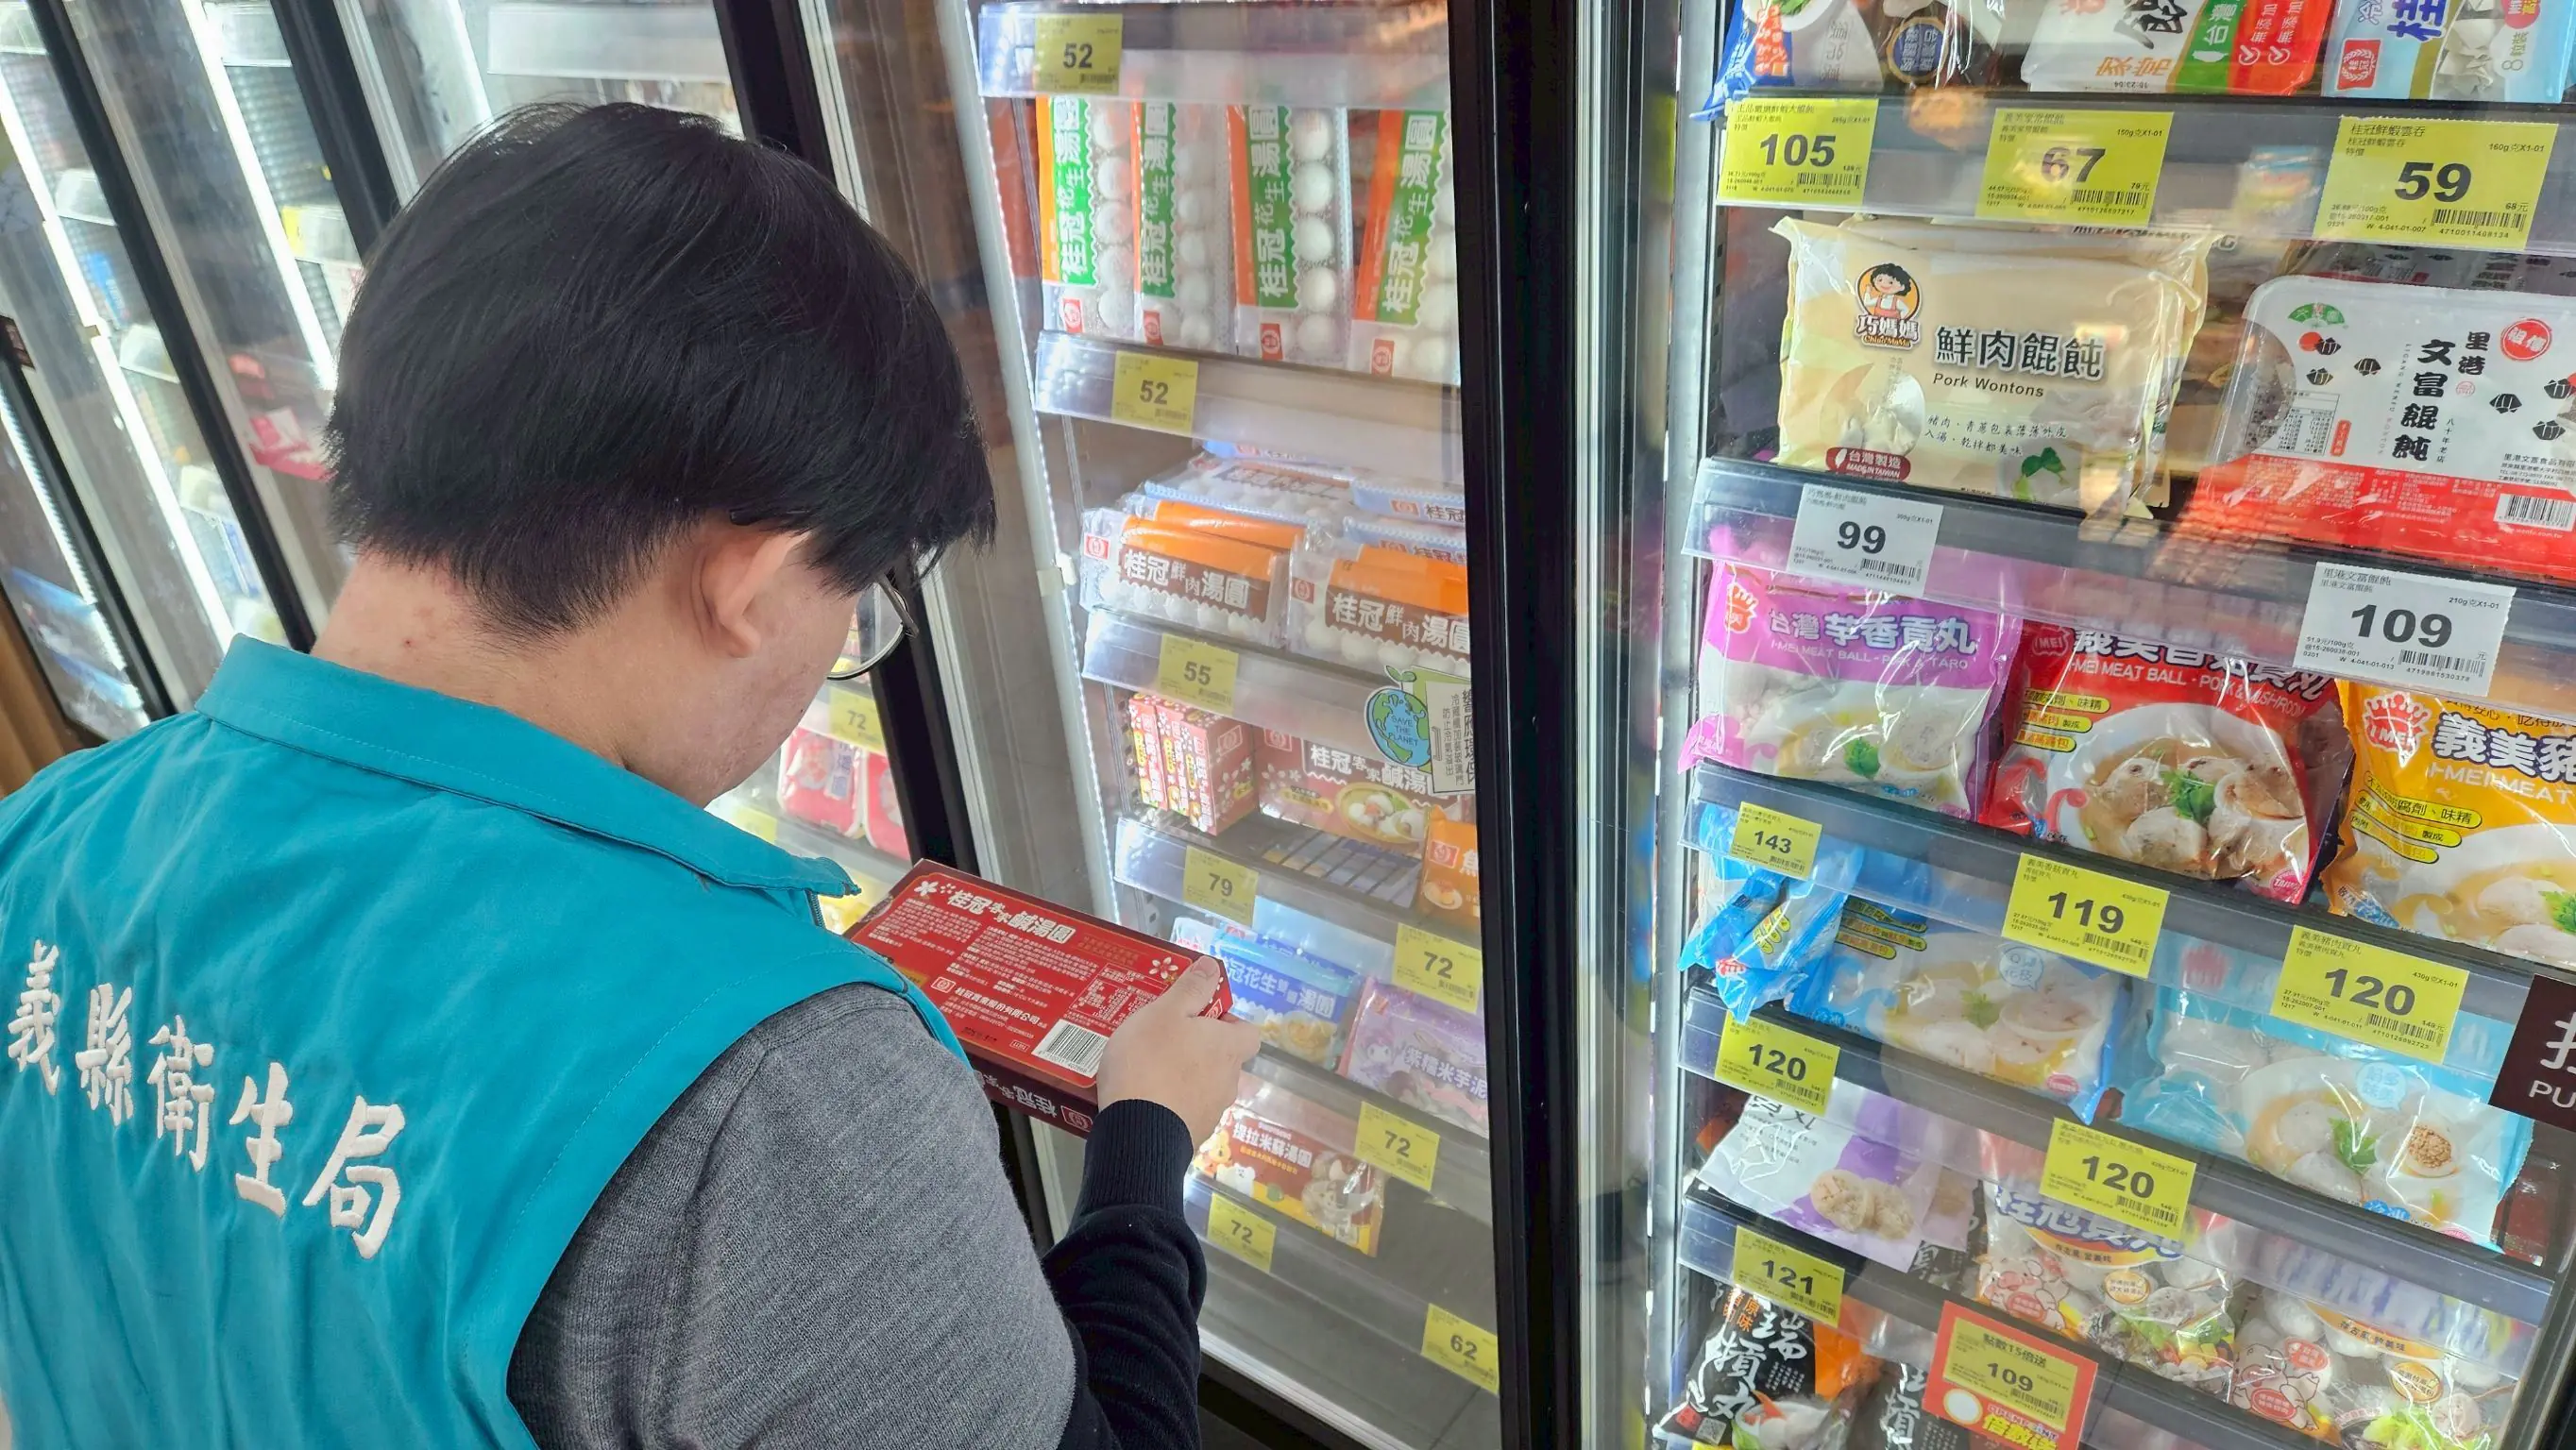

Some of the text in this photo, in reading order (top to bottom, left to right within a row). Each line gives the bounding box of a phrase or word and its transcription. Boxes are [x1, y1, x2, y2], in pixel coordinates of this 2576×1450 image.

[1062, 43, 1093, 69] 52
[2347, 137, 2406, 148] 桂冠鮮蝦雲吞
[2350, 124, 2426, 137] 桂冠鮮蝦雲吞
[1759, 133, 1837, 167] 105
[2041, 145, 2107, 183] 67
[2395, 161, 2471, 202] 59
[1247, 105, 1285, 297] 桂冠花生湯圓
[1382, 113, 1438, 312] 桂冠花生湯圓
[2504, 202, 2529, 212] 68元
[1857, 314, 1919, 340] 巧媽媽
[1936, 327, 2104, 378] 鮮肉餛飩
[2457, 331, 2491, 376] 里港
[1139, 381, 1169, 405] 52
[1933, 373, 2044, 397] Pork Wontons
[2392, 339, 2456, 462] 文富餛飩
[2436, 418, 2455, 464] 八十年老店
[1848, 450, 1902, 467] 台灣製造
[1837, 521, 1887, 554] 99
[1124, 549, 1249, 610] 桂冠鮮肉湯圓
[1331, 592, 1469, 654] 桂冠鮮肉湯圓
[2351, 604, 2452, 648] 109
[1183, 661, 1212, 686] 55
[1838, 649, 1871, 663] BALL
[1931, 657, 1969, 670] TARO
[2102, 661, 2142, 681] MEAT
[2146, 667, 2187, 685] BALL
[847, 710, 867, 730] 72
[1392, 716, 1414, 728] SAVE
[1395, 724, 1412, 734] THE
[1388, 733, 1418, 747] PLANET
[1311, 744, 1433, 795] 桂冠客家鹹湯
[1754, 831, 1791, 853] 143
[1208, 873, 1233, 897] 79
[947, 890, 1076, 944] 桂冠客家鹹湯圓
[2047, 891, 2124, 934] 119
[1423, 951, 1453, 979] 72
[2325, 969, 2415, 1016] 120
[1749, 1043, 1806, 1081] 120
[8, 938, 406, 1260] 義縣衛生局
[1383, 1129, 1410, 1157] 72
[2082, 1155, 2155, 1199] 120
[1230, 1220, 1253, 1244] 72
[1761, 1260, 1813, 1295] 121
[1737, 1298, 1760, 1332] 原味
[1449, 1334, 1478, 1361] 62
[1988, 1362, 2033, 1391] 109
